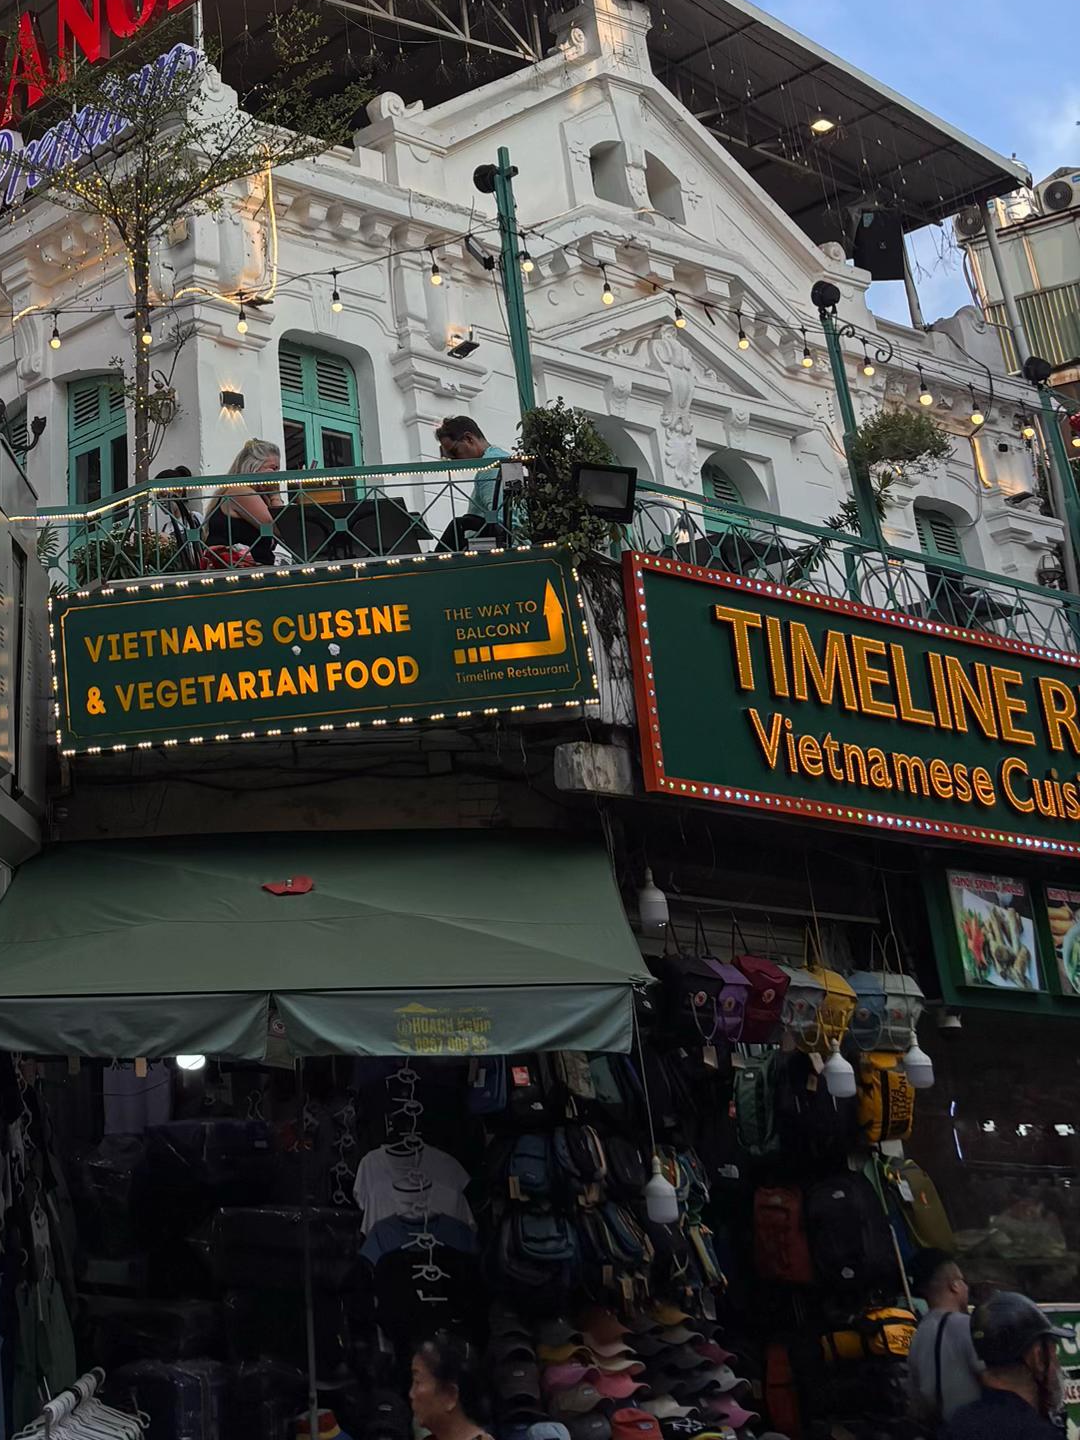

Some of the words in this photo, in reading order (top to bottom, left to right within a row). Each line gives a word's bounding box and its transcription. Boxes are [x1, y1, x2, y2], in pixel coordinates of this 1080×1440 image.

[83, 619, 264, 663] VIETNAMES
[273, 604, 412, 645] CUISINE
[444, 607, 473, 621] THE
[476, 603, 511, 617] WAY
[515, 600, 537, 613] TO
[456, 621, 530, 640] BALCONY
[86, 686, 107, 715] &
[115, 665, 319, 712] VEGETARIAN
[326, 656, 420, 692] FOOD
[456, 668, 504, 684] Timeline
[506, 663, 570, 679] Restaurant
[715, 604, 1036, 746] TIMELINE
[1037, 676, 1080, 755] R
[748, 707, 997, 807] Vietnamese
[1001, 756, 1080, 821] Cuis
